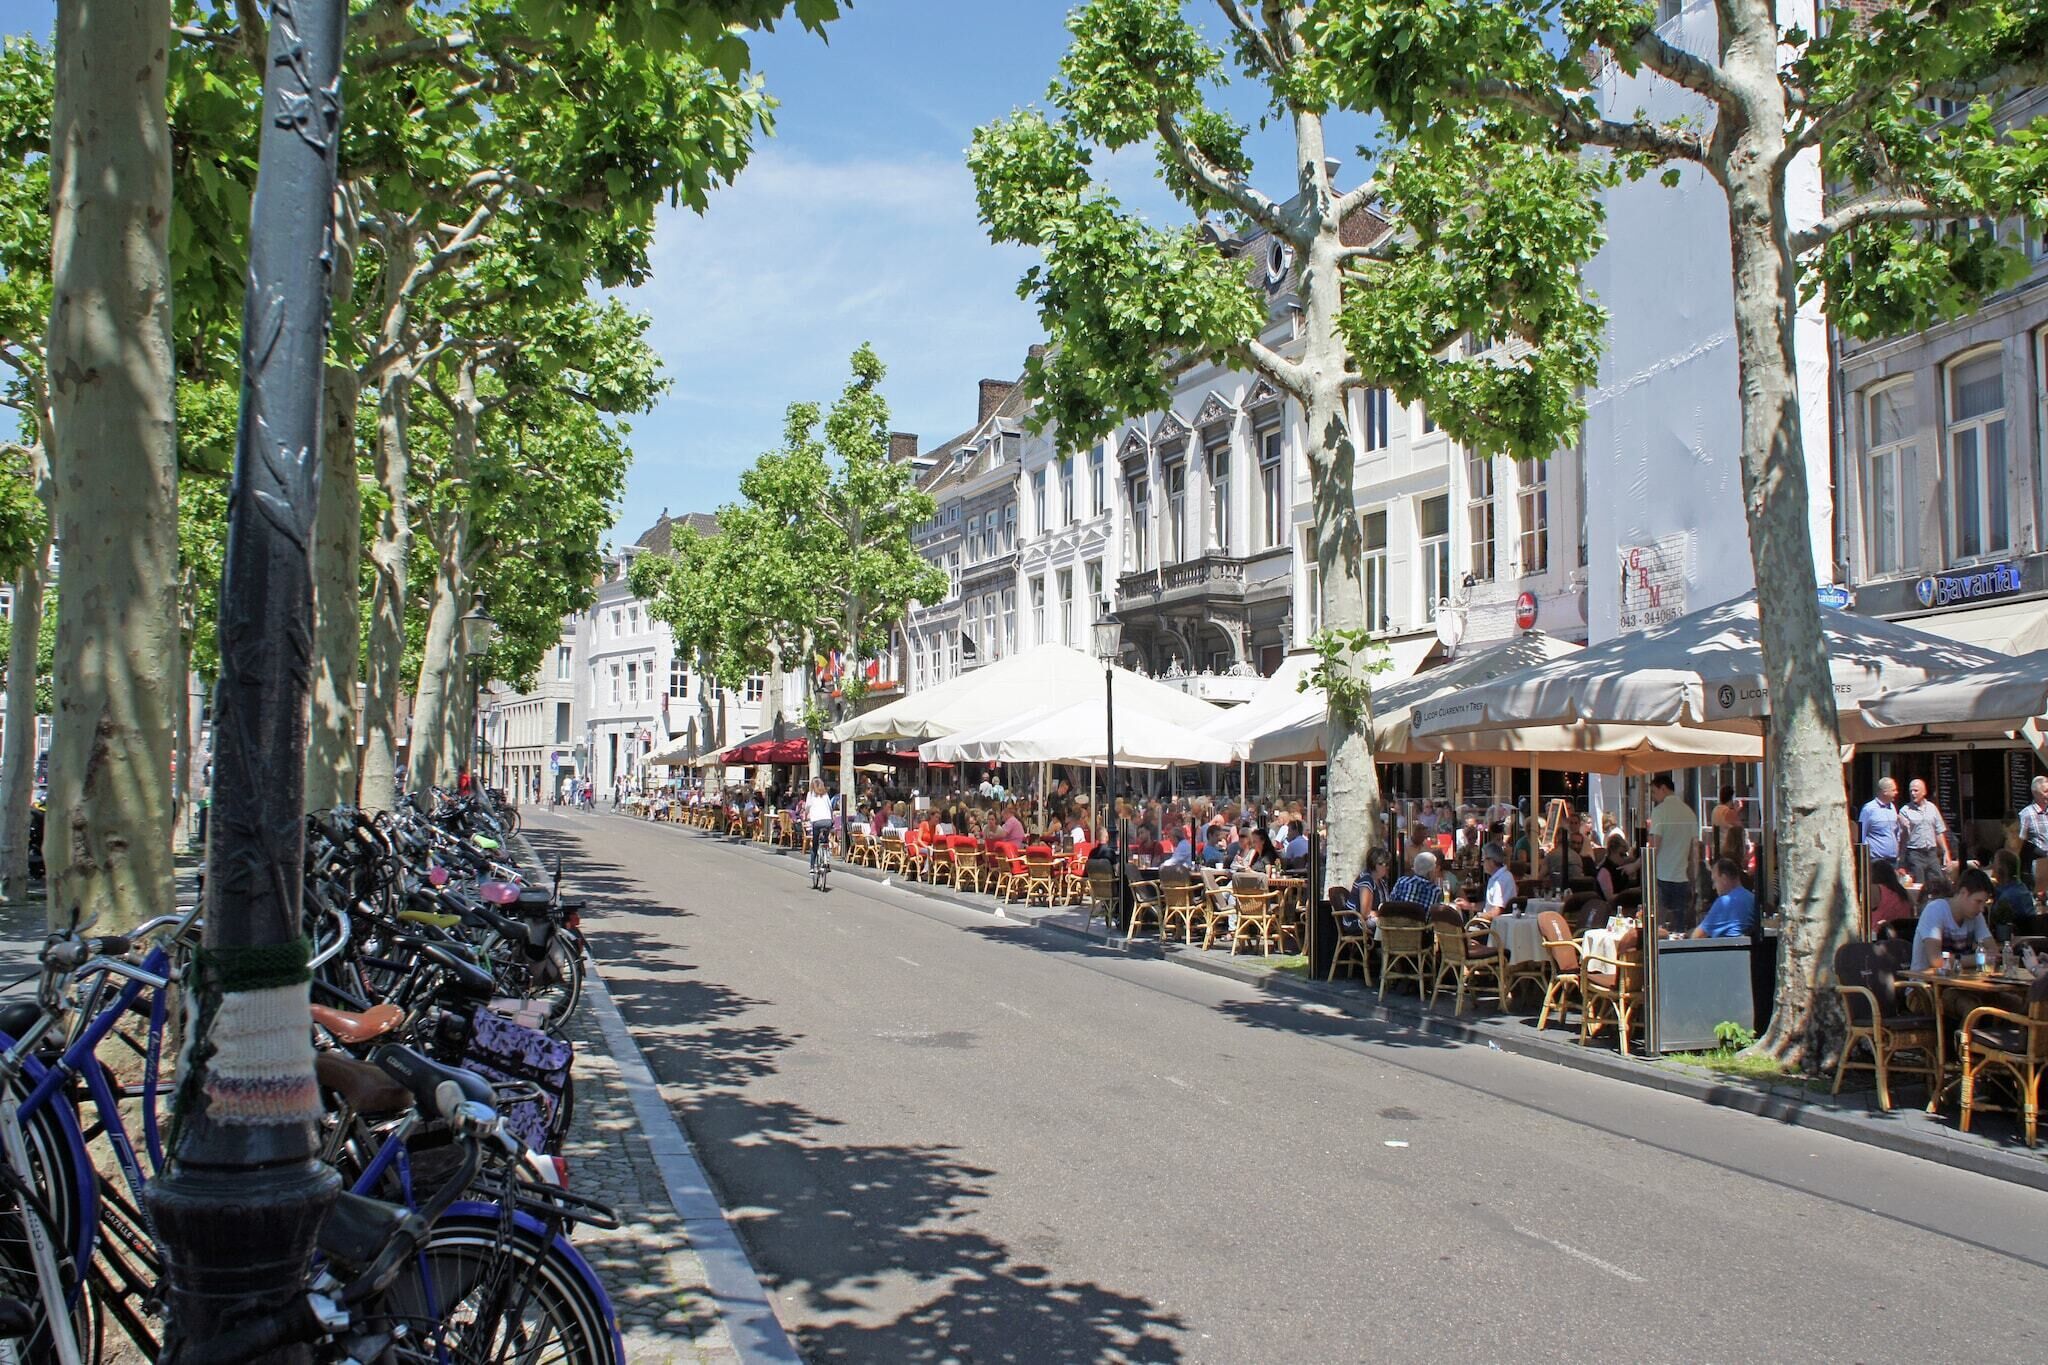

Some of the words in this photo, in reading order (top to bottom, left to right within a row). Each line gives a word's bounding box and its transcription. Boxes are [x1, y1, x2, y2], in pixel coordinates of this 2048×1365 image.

[1936, 566, 2016, 606] Bavaria
[1818, 592, 1845, 604] avaria
[1620, 614, 1636, 628] 043
[1740, 688, 1769, 700] LICOR
[105, 1210, 134, 1240] GAZELLE
